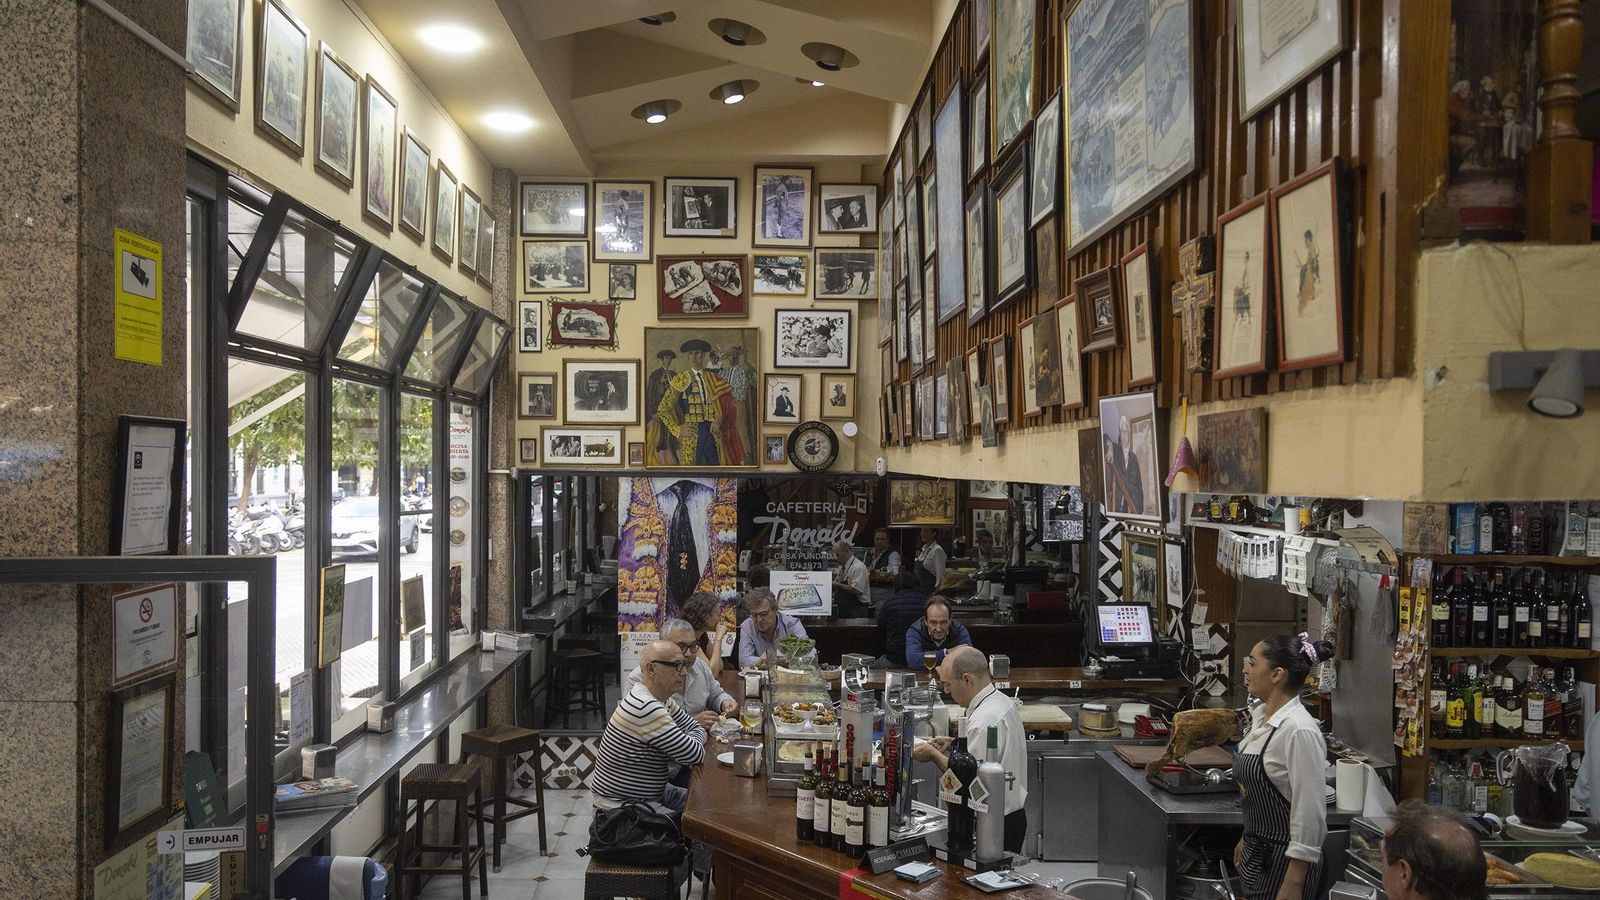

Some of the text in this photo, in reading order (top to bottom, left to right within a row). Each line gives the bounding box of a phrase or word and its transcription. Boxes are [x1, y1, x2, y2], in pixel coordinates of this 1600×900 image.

[766, 501, 847, 513] CAFETERIA
[753, 515, 859, 548] Donald
[774, 552, 838, 560] CASA FUNDADA
[188, 834, 239, 845] EMPUJAR
